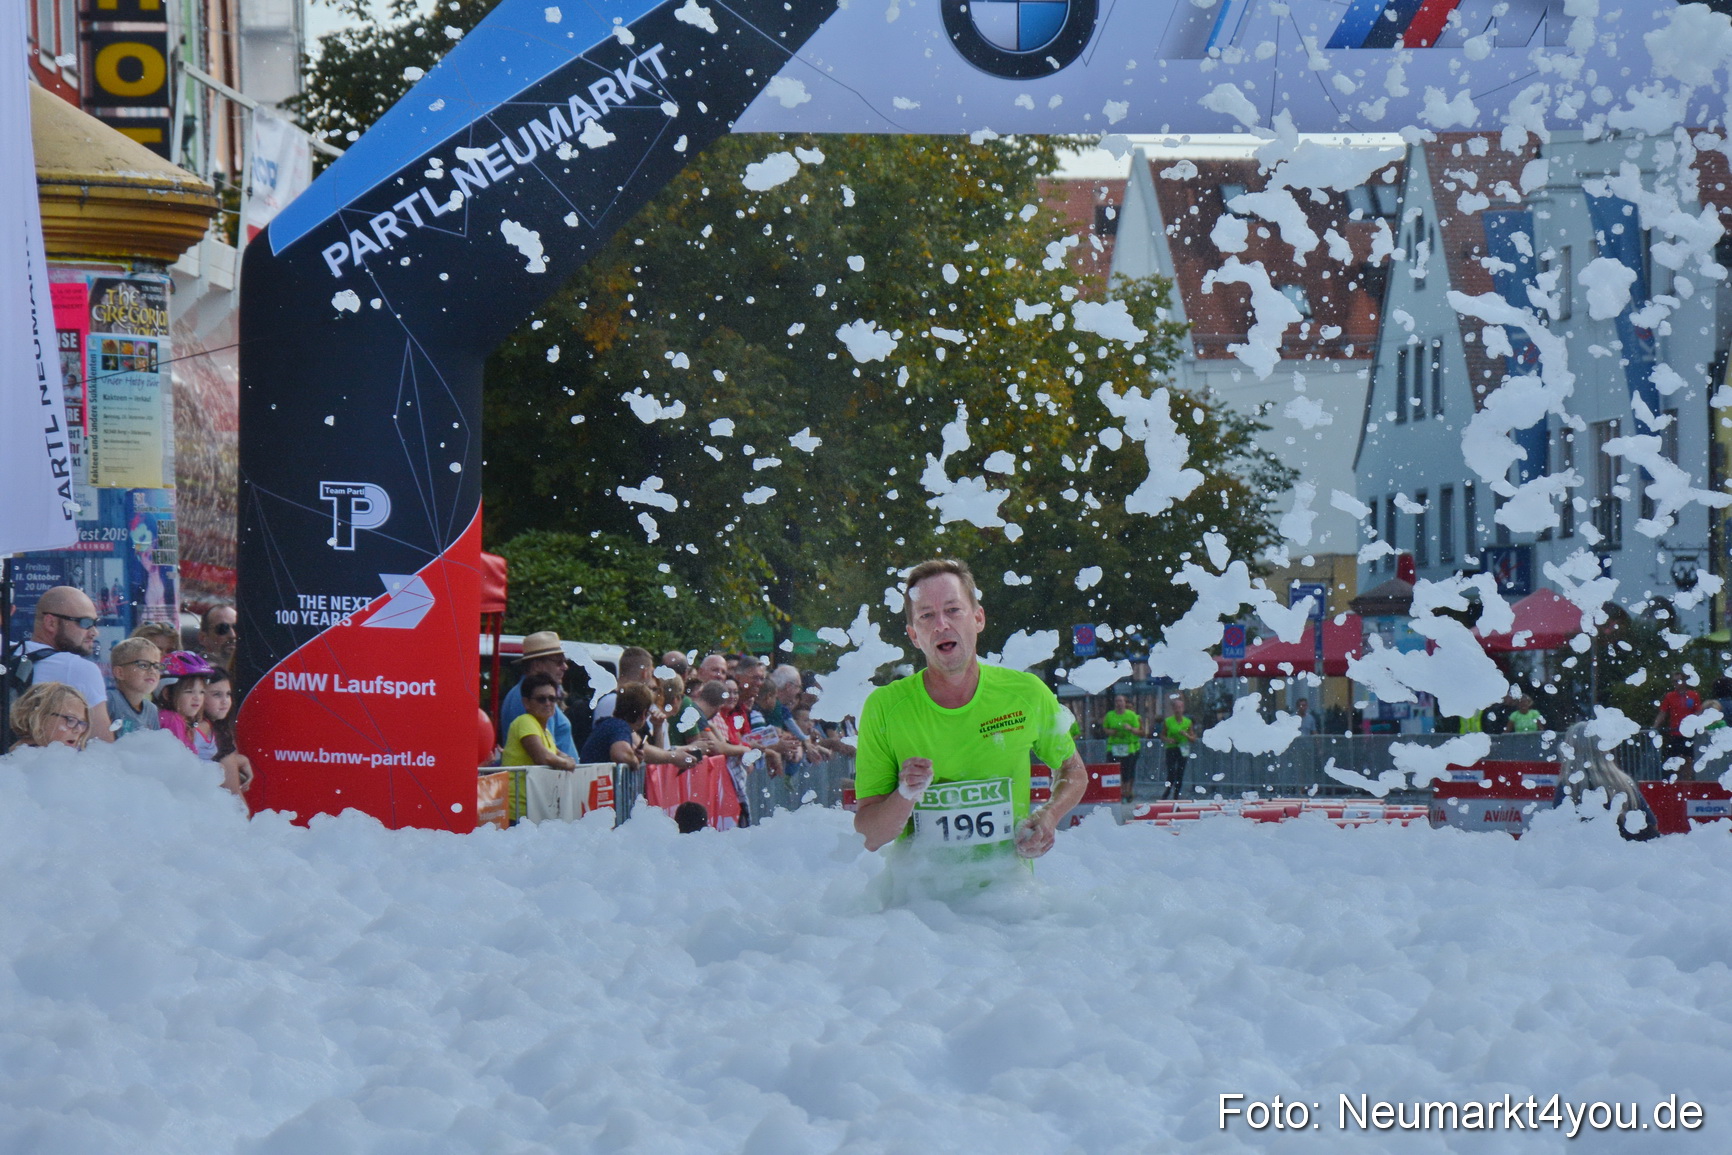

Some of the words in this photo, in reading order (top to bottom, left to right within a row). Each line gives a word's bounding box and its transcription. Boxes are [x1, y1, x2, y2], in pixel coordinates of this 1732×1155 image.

[321, 186, 454, 279] PARTL
[450, 42, 669, 200] NEUMARKT
[59, 332, 77, 348] SE
[89, 354, 97, 402] Sukkulenten
[65, 407, 80, 421] RE
[89, 405, 98, 432] andere
[68, 428, 80, 439] ert
[90, 434, 98, 449] und
[69, 442, 81, 454] hr
[71, 457, 81, 467] kt
[90, 452, 98, 484] Kakteen
[324, 486, 346, 495] Team
[77, 527, 100, 541] fest
[101, 527, 128, 541] 2019
[25, 563, 51, 572] Freitag
[26, 573, 61, 581] Oktober
[25, 583, 35, 591] 20
[36, 583, 52, 591] Uhr
[297, 593, 327, 610] THE
[331, 595, 373, 612] NEXT
[275, 609, 298, 625] 100
[300, 610, 353, 627] YEARS
[1225, 647, 1243, 656] TAXI
[274, 671, 328, 693] BMW
[333, 674, 436, 699] Laufsport
[979, 716, 1027, 733] ELEMENTELAUF
[980, 710, 1023, 728] NEUMARKTER
[274, 748, 436, 769] www.bmw-partl.de
[920, 782, 1002, 807] BOCK
[935, 811, 995, 842] 196
